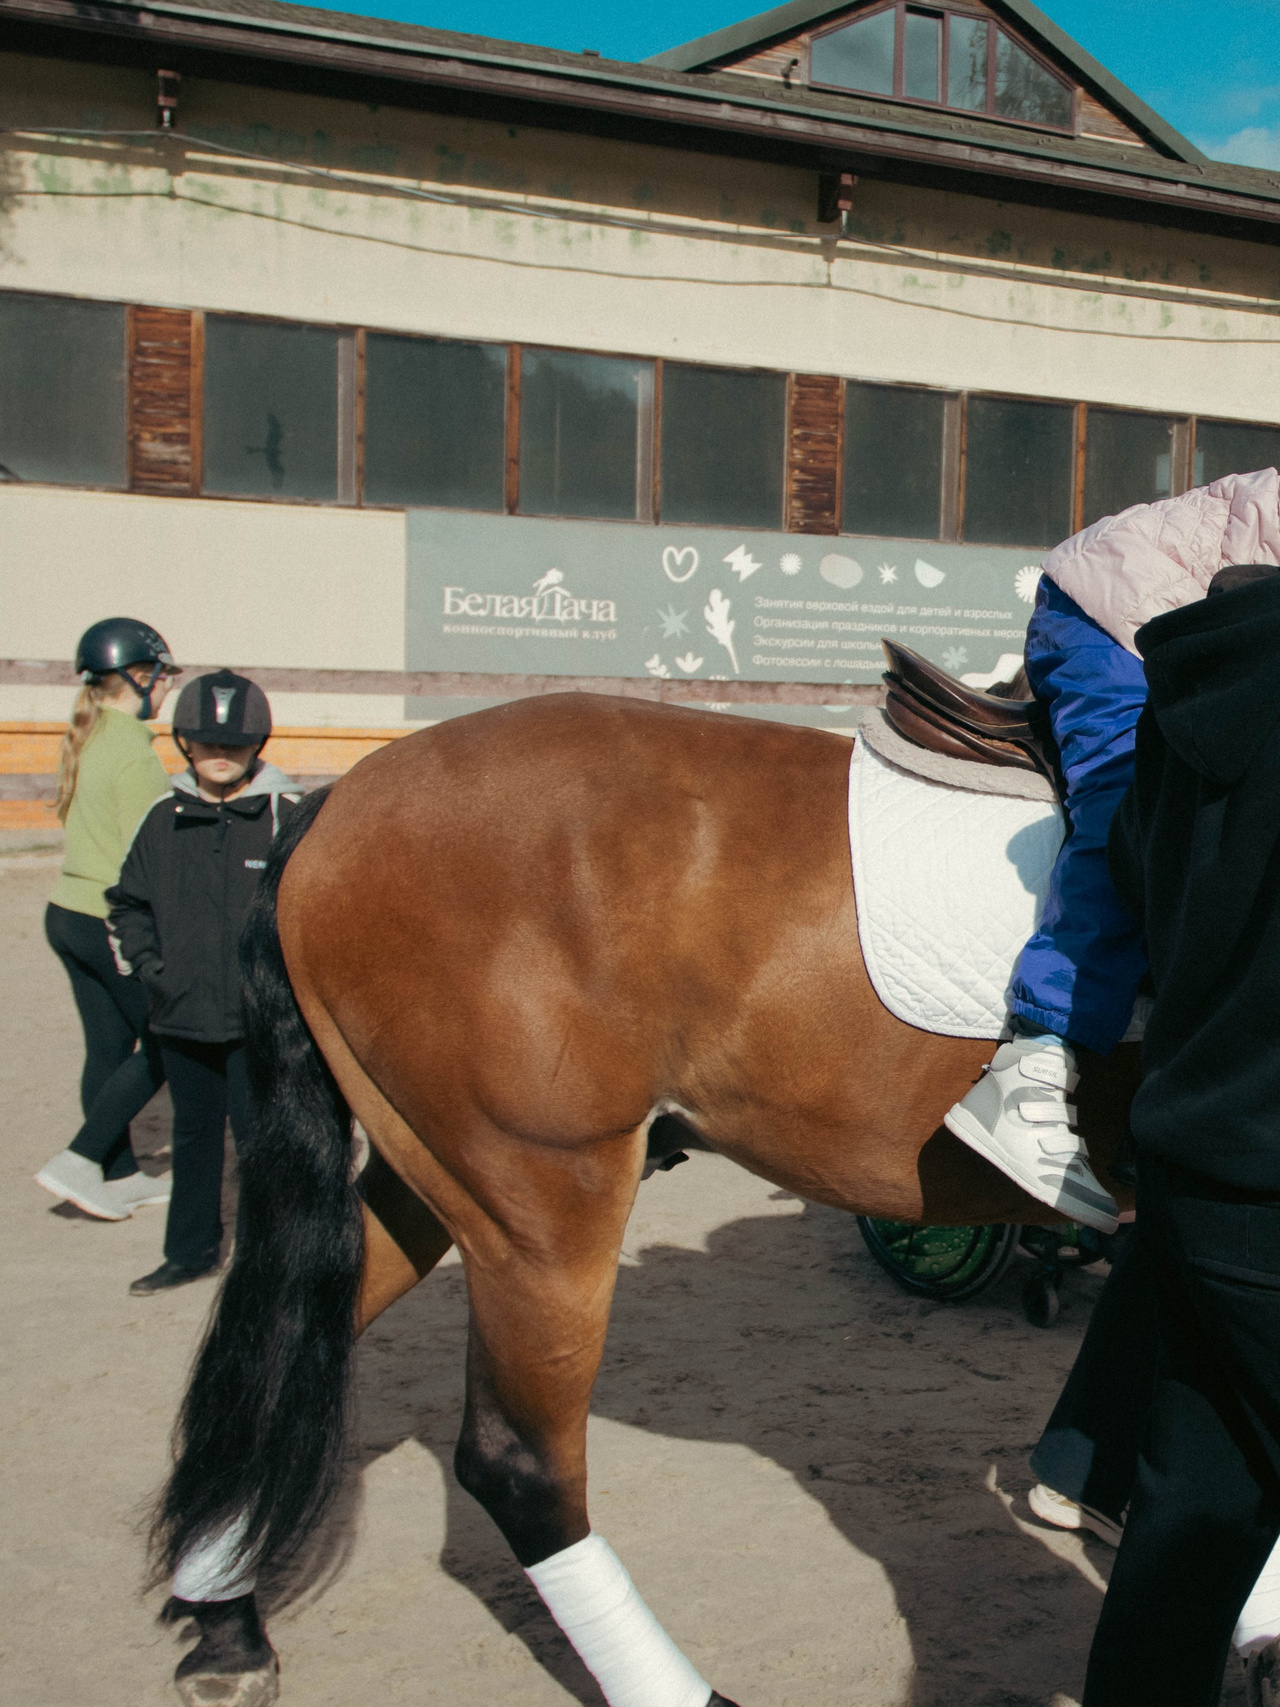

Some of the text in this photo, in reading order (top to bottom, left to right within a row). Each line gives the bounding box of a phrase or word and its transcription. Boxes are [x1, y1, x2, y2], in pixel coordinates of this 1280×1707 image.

[754, 596, 803, 609] Занятия
[805, 601, 858, 612] верховой
[860, 603, 894, 614] ездой
[896, 605, 917, 615] для
[919, 607, 951, 617] детей
[963, 609, 1013, 620] взрослых
[443, 622, 618, 641] конноспортивный клуб
[753, 615, 1028, 640] Организация праздников и корпоративных мероп
[753, 635, 883, 650] Экскурсии для школьн
[752, 655, 821, 667] Фотосессии
[824, 659, 831, 667] с
[1033, 1066, 1058, 1078] SURSIL
